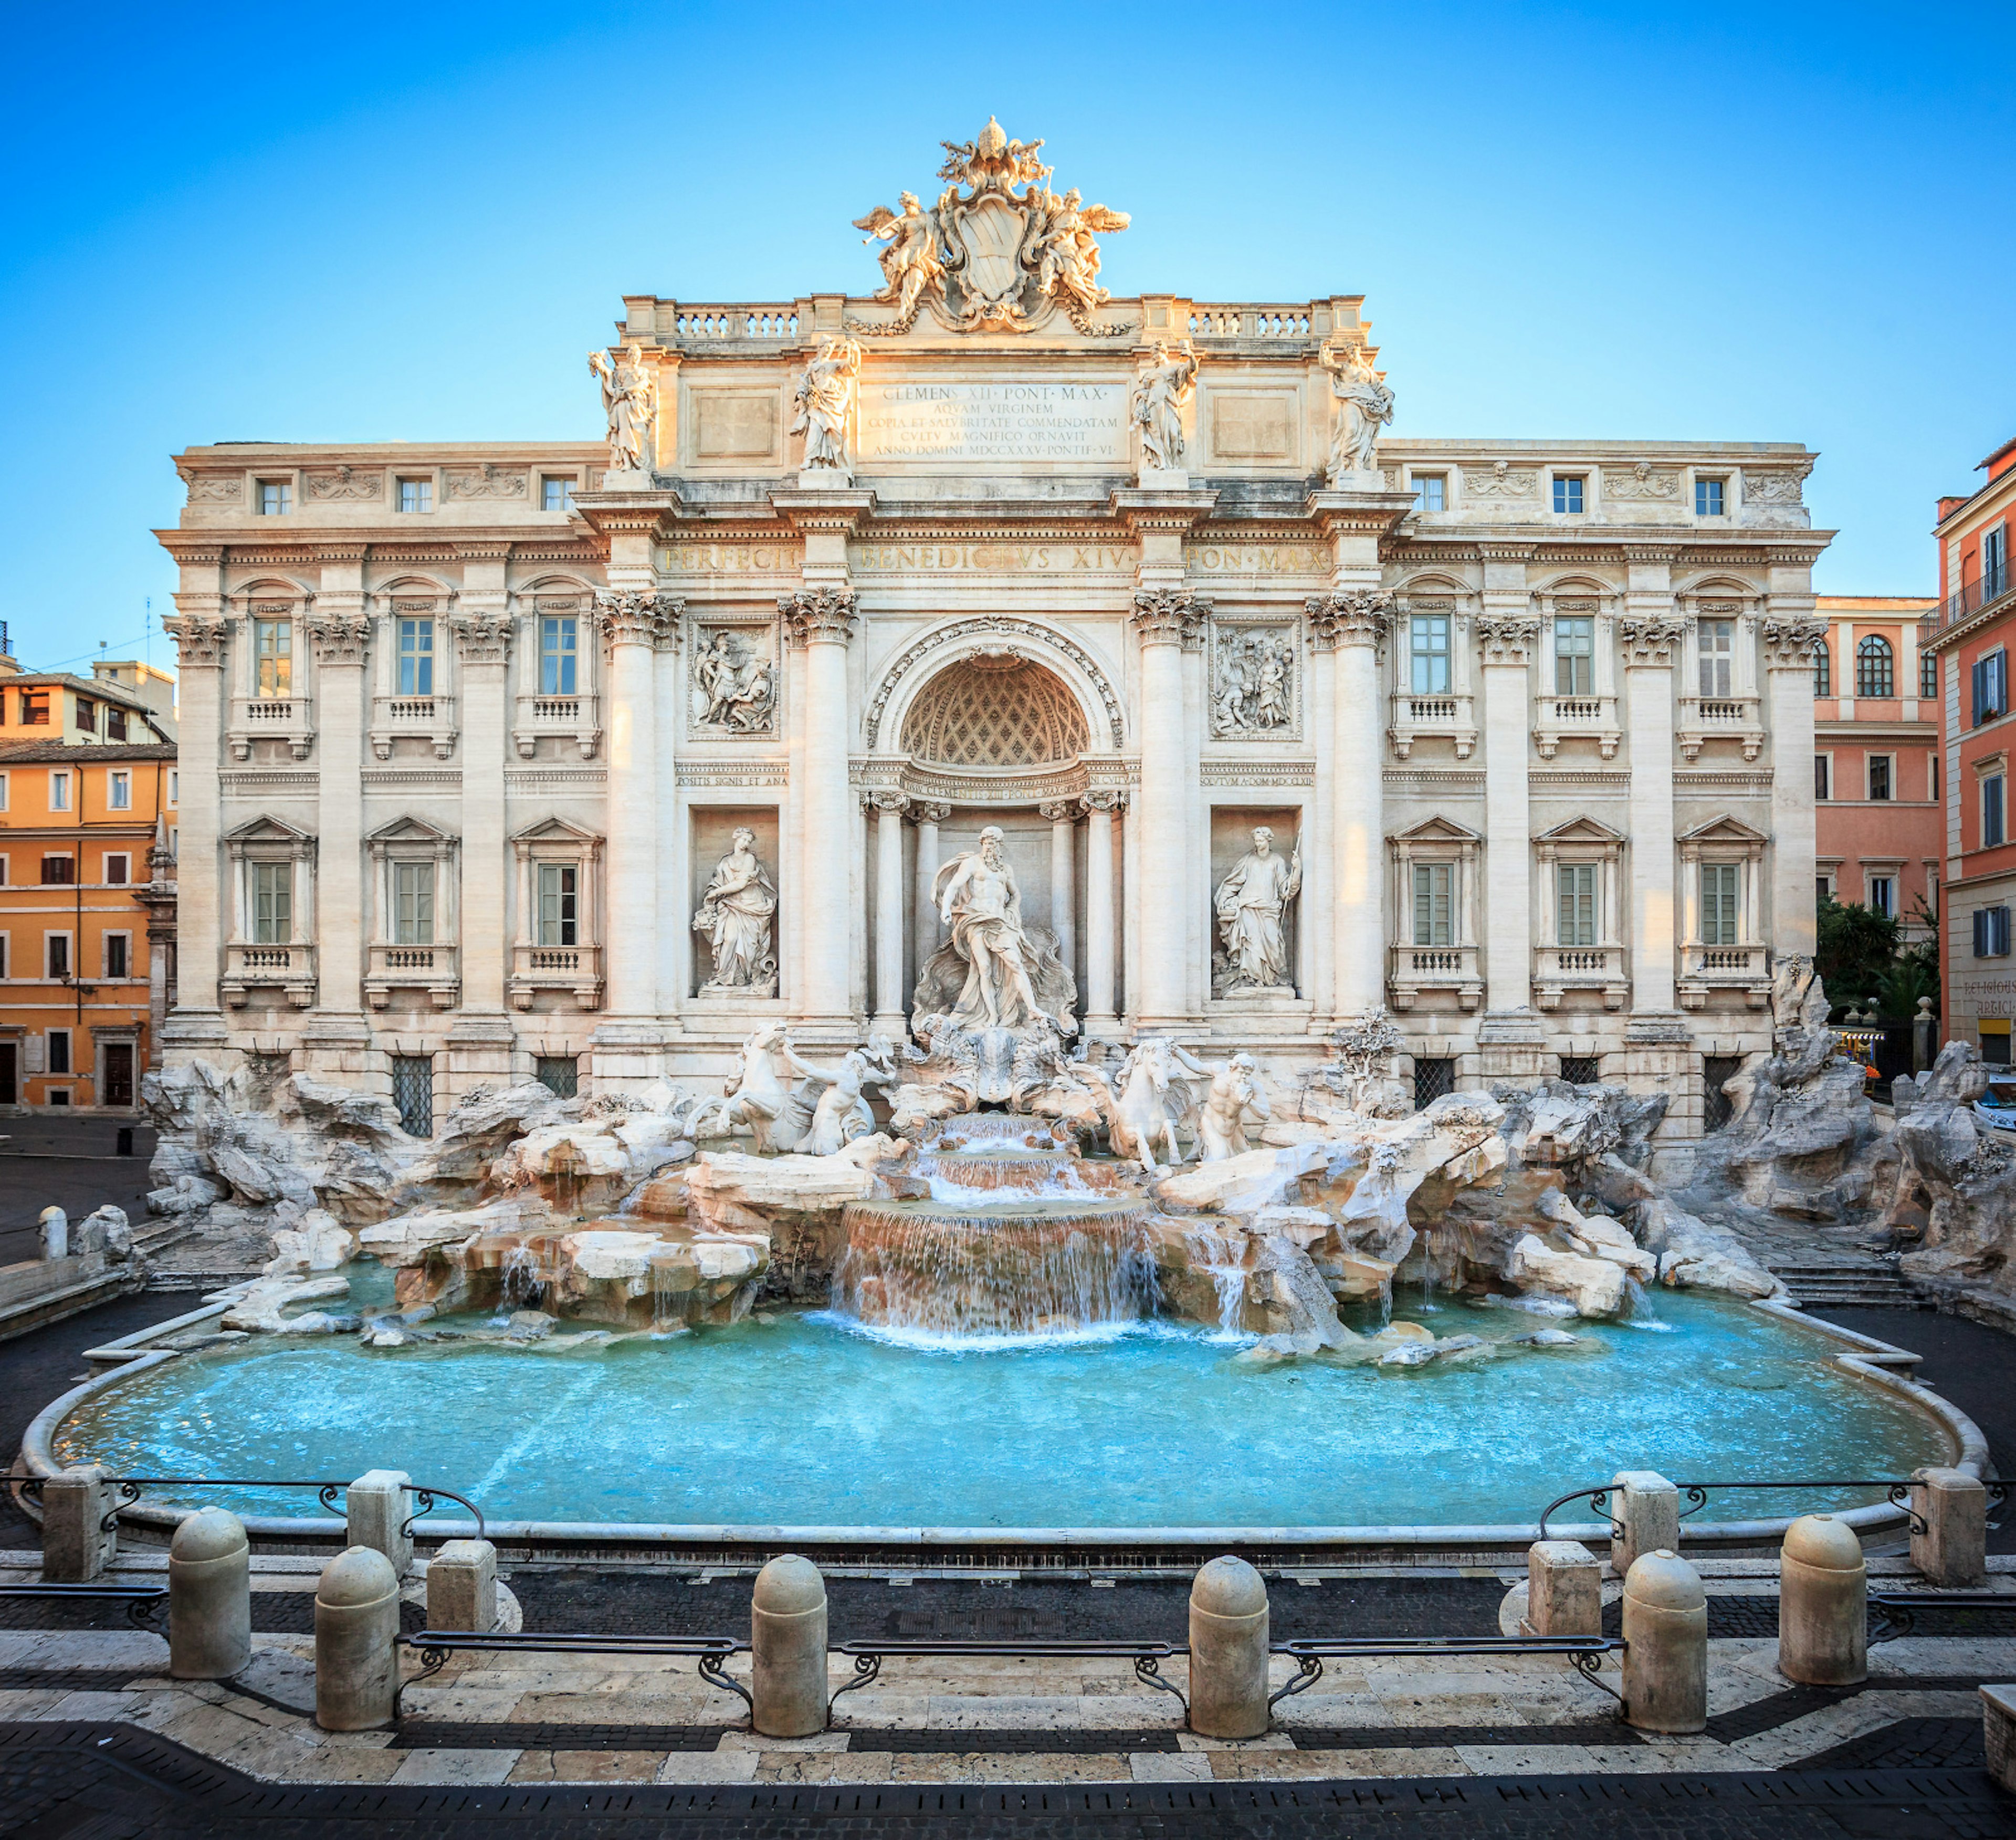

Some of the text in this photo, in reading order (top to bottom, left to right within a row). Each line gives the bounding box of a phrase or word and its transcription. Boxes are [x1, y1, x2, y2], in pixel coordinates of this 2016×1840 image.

[883, 388, 958, 400] CLEMENS
[934, 404, 1053, 416] AQVAM VIRGINEM
[869, 418, 1117, 427] COPIA ET SALVBRITATE COMMENDATAM
[900, 432, 1086, 441] CVLTV MAGNIFICO ORNAVIT
[874, 445, 912, 455] ANNO
[916, 445, 963, 455] DOMINI
[665, 548, 802, 570] PERFECIT
[862, 547, 1049, 569] BENEDICTVS
[678, 777, 788, 786] POSITIS SIGNIS ET ANA
